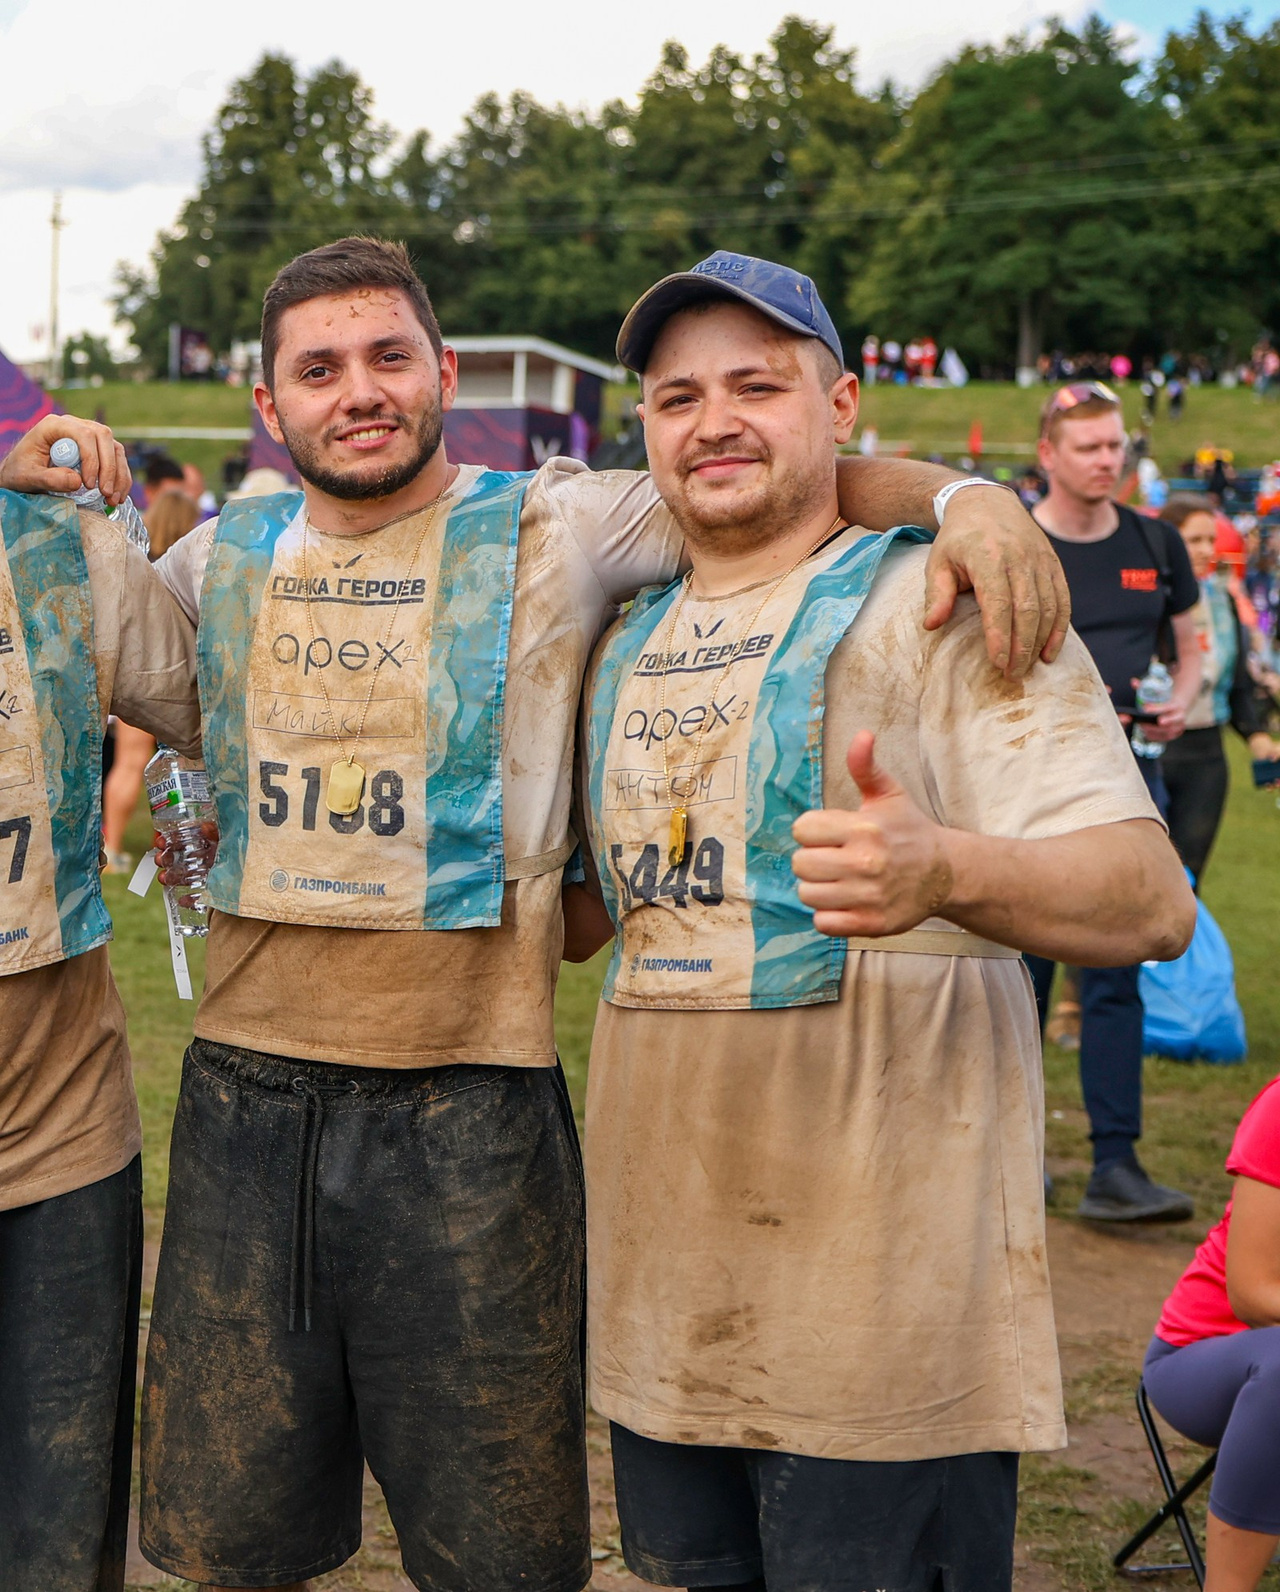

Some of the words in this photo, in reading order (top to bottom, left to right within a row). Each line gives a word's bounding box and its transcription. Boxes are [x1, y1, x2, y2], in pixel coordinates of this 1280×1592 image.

[272, 576, 329, 596] ГОНКА
[336, 578, 427, 599] ГЕРОЕВ
[272, 633, 406, 676] apex
[637, 651, 685, 670] ГОНКА
[691, 633, 775, 666] ГЕРОЕВ
[624, 694, 737, 751] apex
[294, 876, 387, 897] ГАЗПРОМБАНК
[641, 958, 713, 973] ГАЗПРОМБАНК
